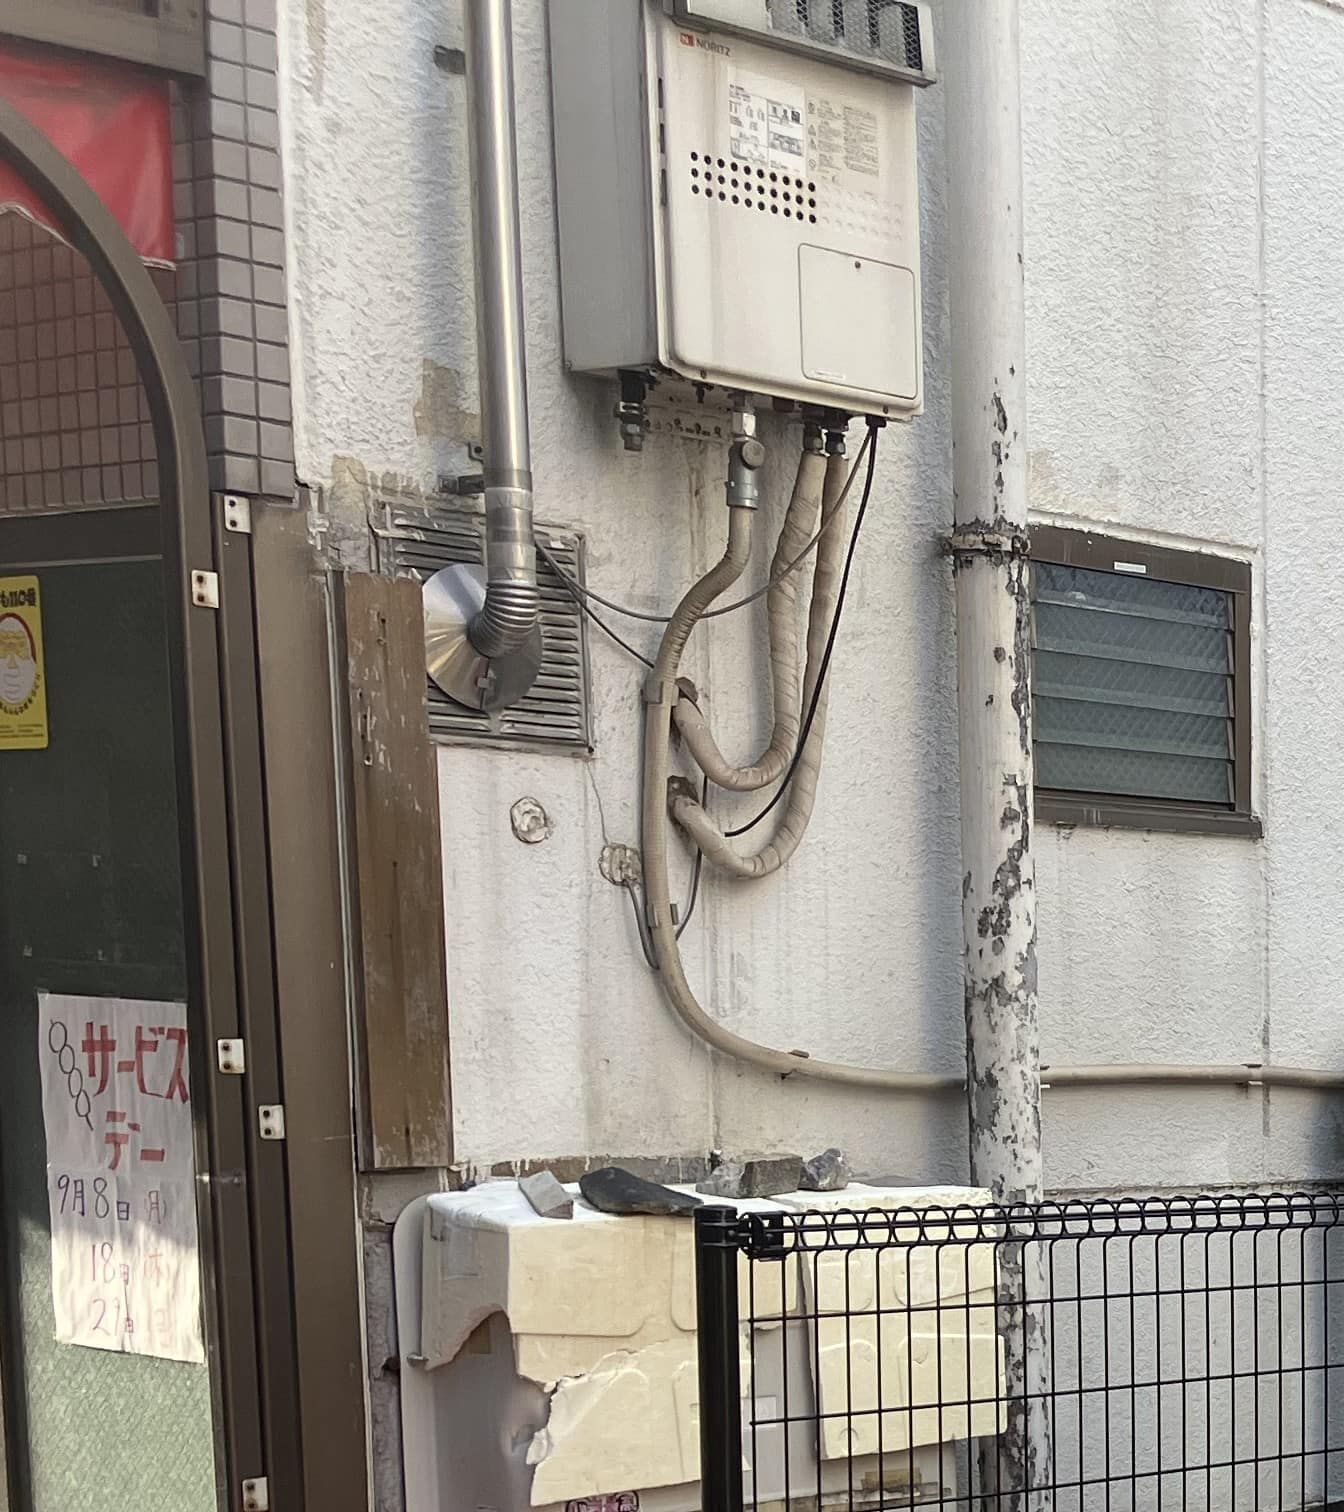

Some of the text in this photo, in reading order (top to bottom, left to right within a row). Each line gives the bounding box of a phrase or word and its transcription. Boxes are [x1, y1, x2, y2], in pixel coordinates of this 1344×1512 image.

[82, 1022, 190, 1104] サービス
[104, 1111, 166, 1171] デー
[57, 1174, 130, 1221] 9月8日
